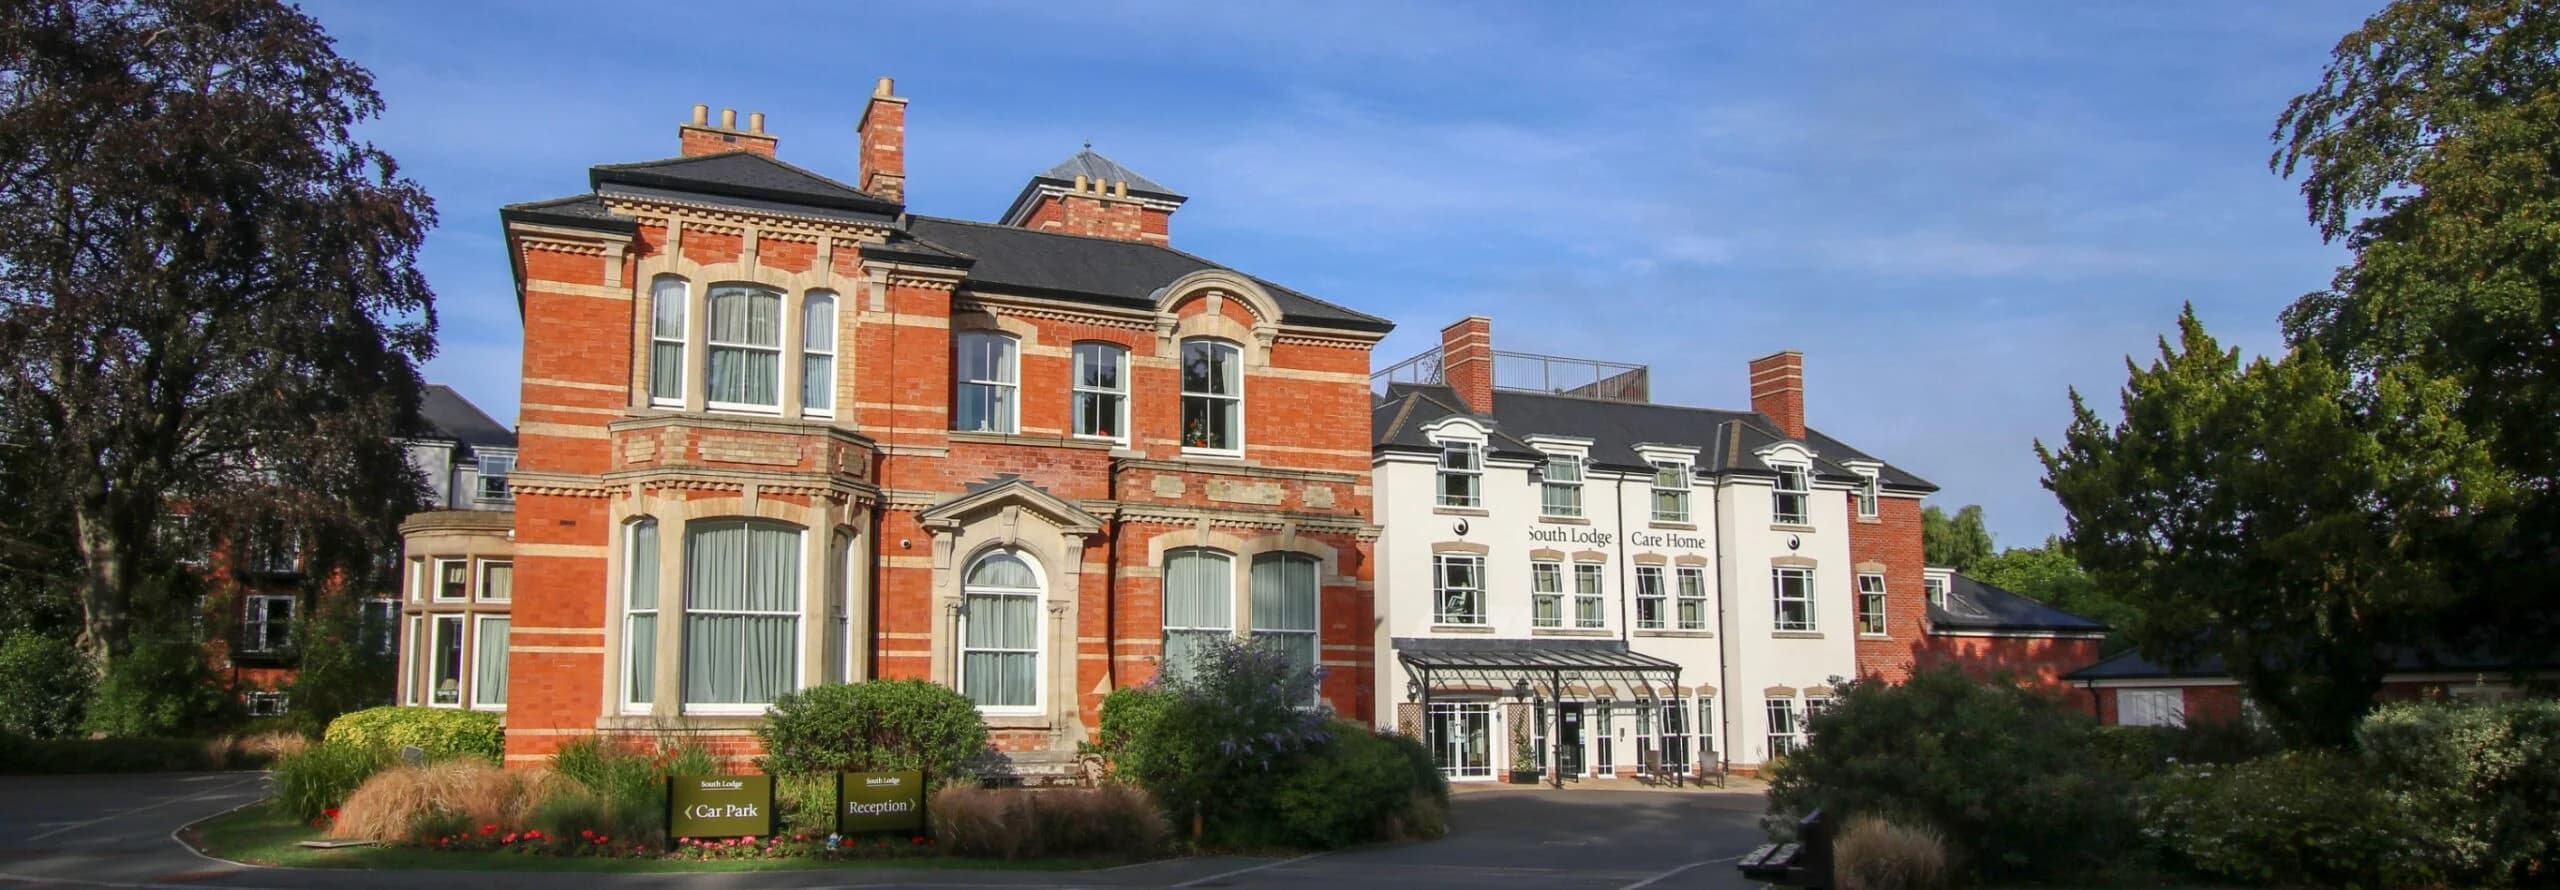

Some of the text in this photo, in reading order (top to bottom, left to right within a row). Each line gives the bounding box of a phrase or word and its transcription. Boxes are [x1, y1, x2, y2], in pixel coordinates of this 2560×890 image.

[1571, 527, 1612, 547] Lodge
[1631, 531, 1662, 547] Care
[1666, 533, 1706, 549] Home
[722, 780, 743, 790] Lodge
[696, 803, 758, 818] Car Park
[849, 799, 907, 816] Reception
